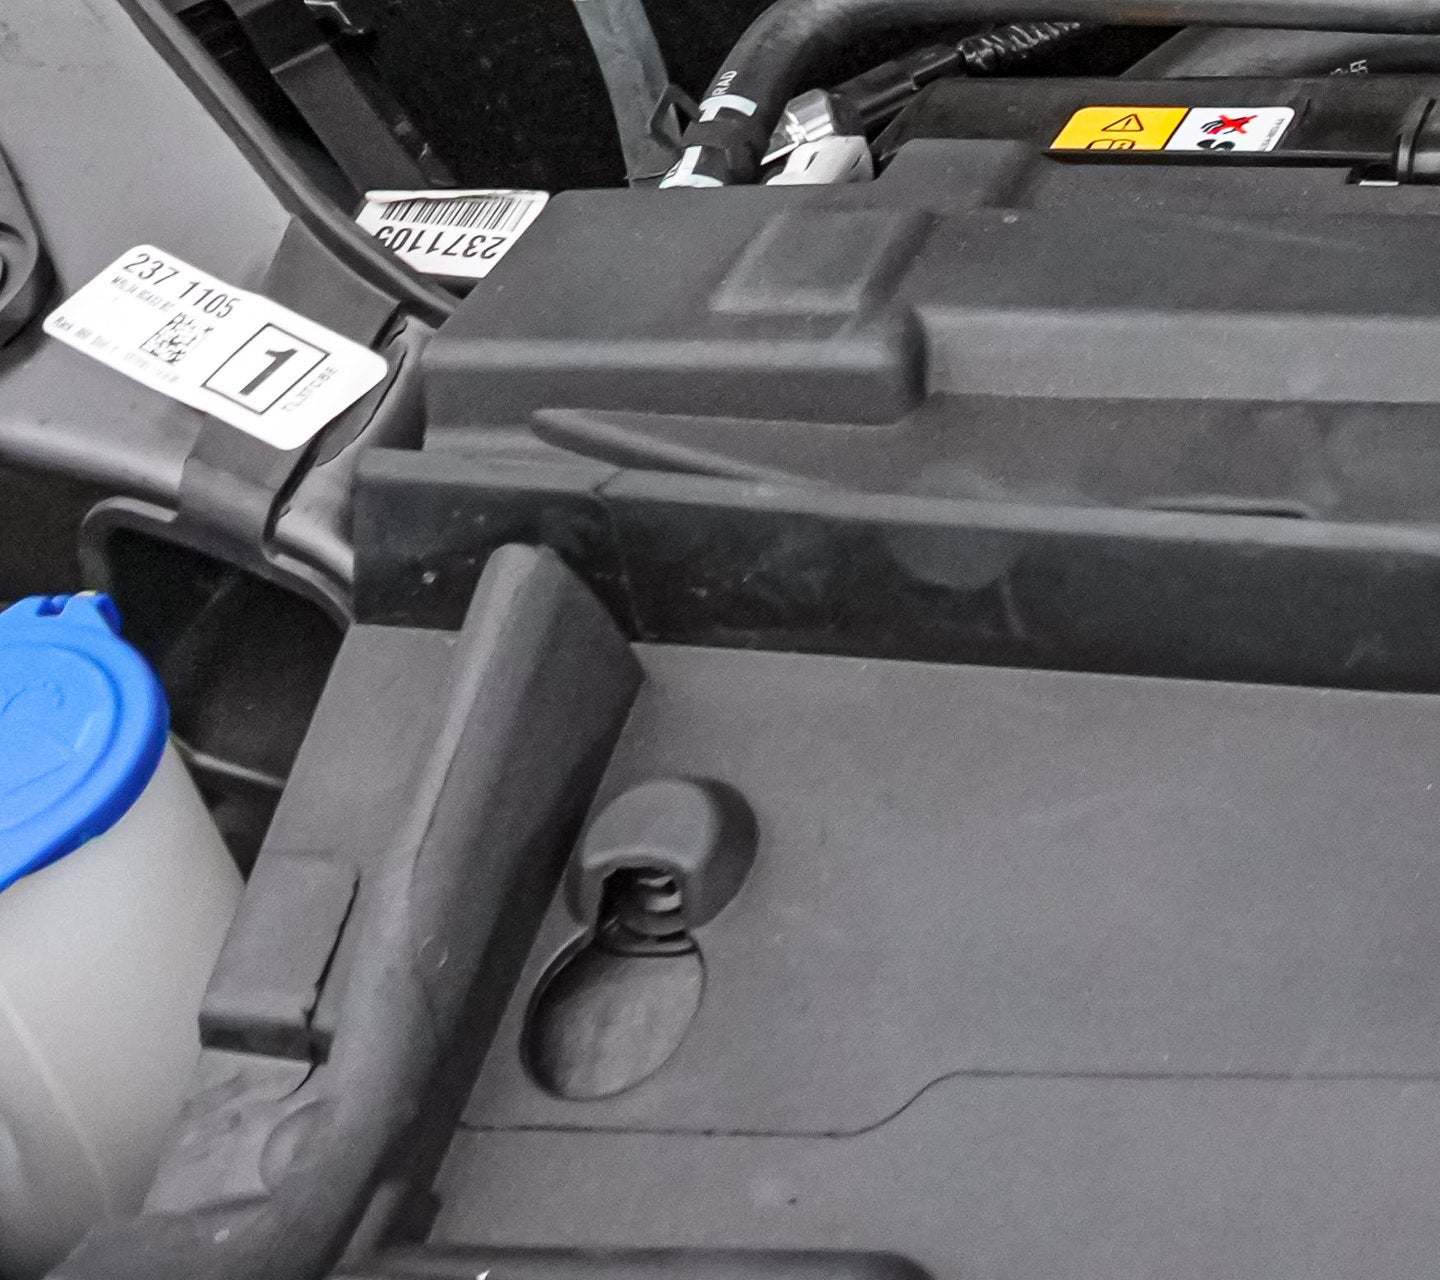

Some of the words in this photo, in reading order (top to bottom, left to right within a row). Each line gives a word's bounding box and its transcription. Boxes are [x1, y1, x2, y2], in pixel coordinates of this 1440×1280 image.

[373, 225, 508, 260] 2371105
[123, 253, 180, 286] 237
[178, 281, 242, 319] 1105
[239, 347, 299, 397] 1
